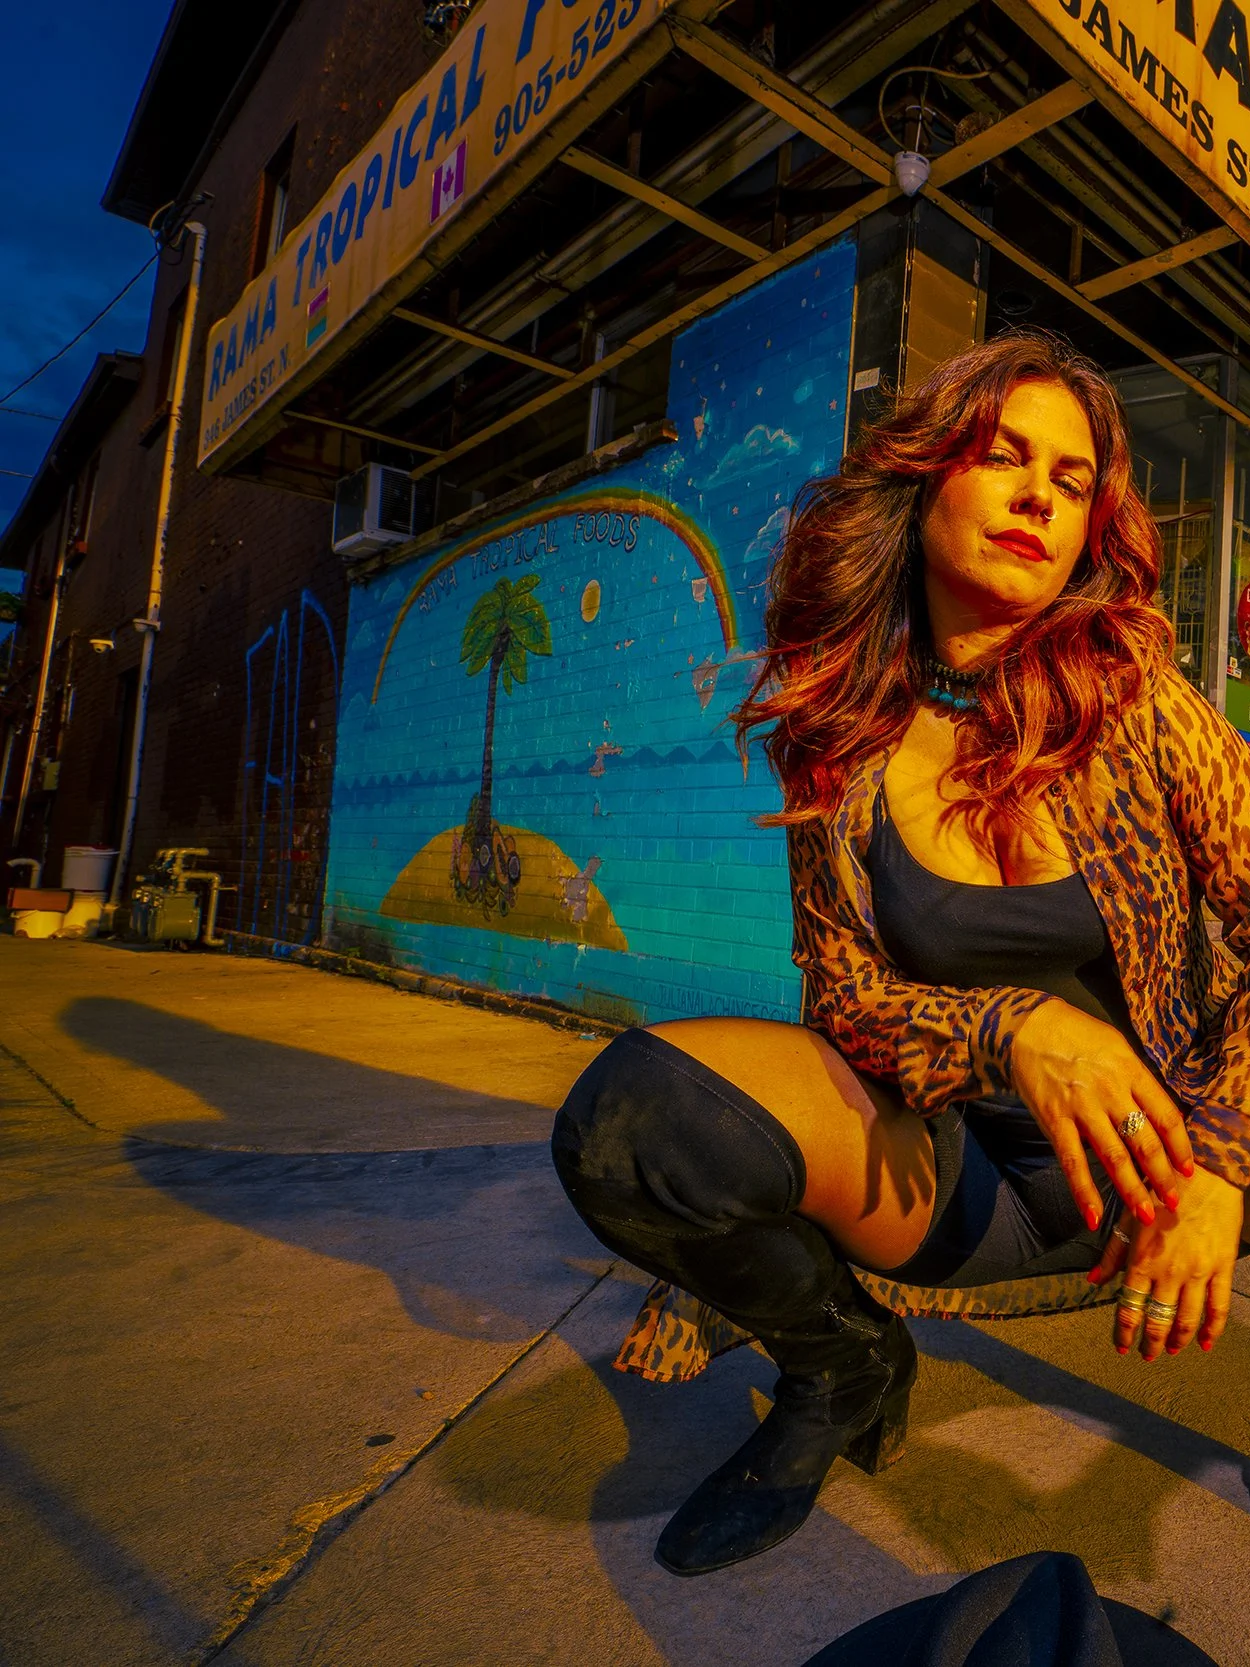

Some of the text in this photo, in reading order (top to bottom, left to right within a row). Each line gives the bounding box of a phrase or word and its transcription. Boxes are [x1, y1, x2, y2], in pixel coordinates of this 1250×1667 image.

[208, 23, 487, 402] RAMA TROPICAL
[222, 377, 257, 432] JAMES
[470, 520, 561, 579] TROPICAL
[573, 511, 642, 552] FOODS
